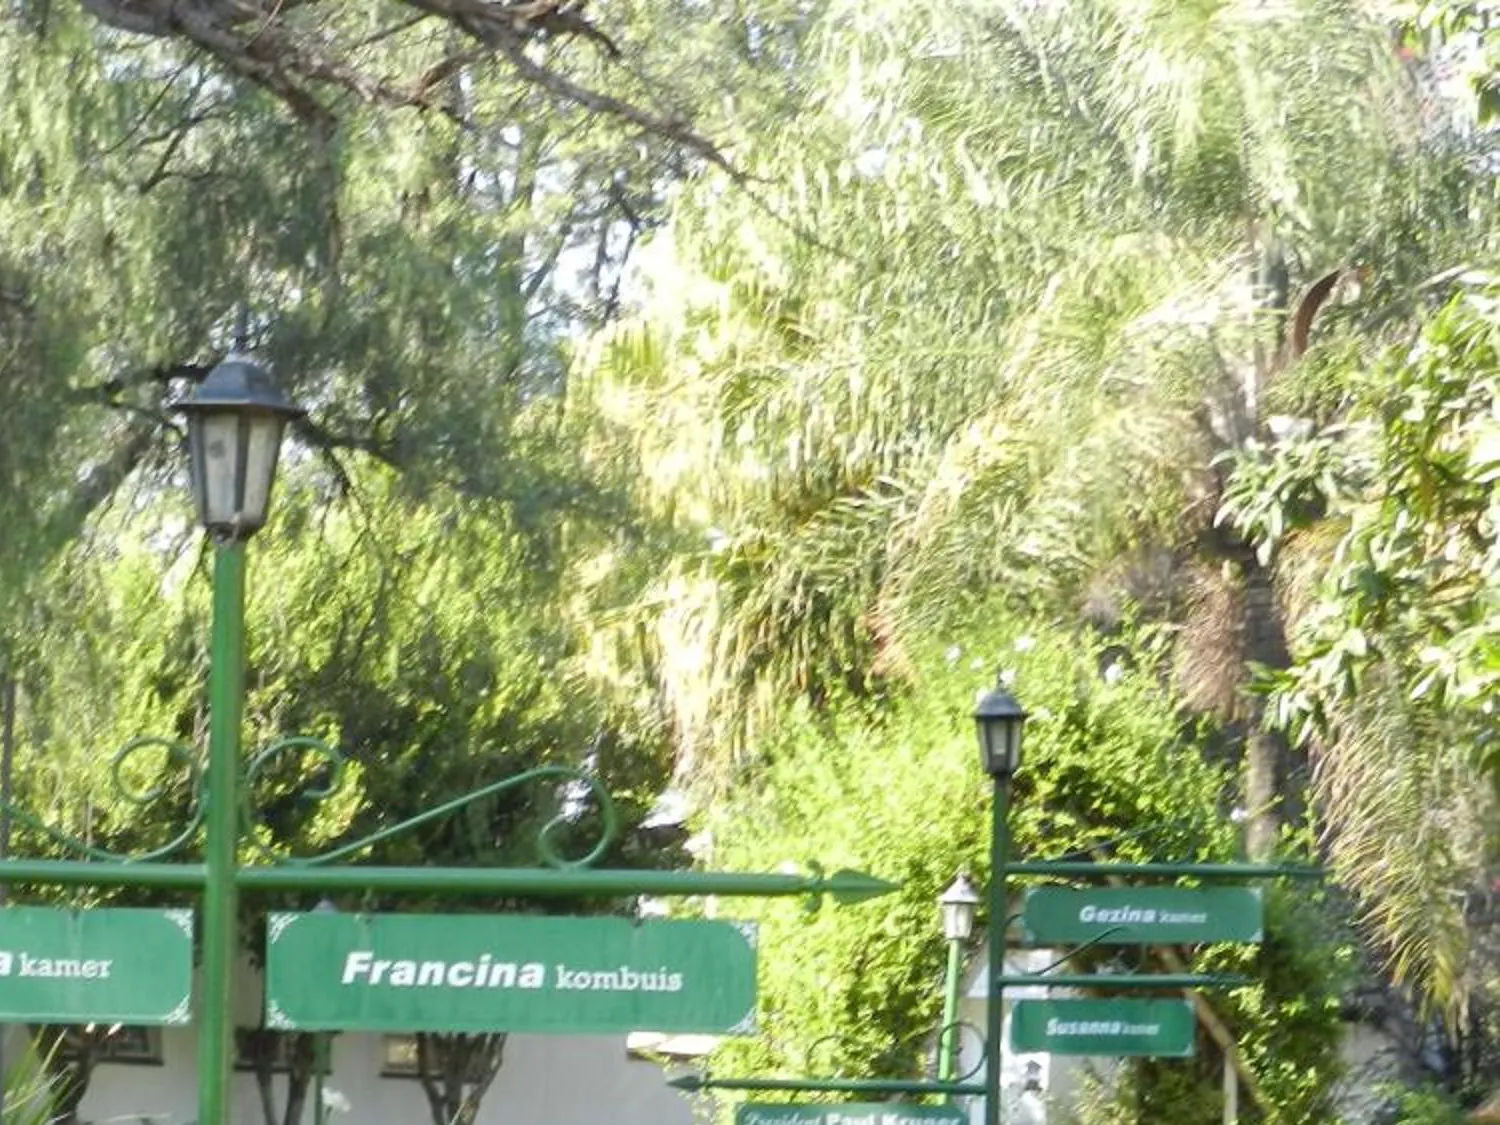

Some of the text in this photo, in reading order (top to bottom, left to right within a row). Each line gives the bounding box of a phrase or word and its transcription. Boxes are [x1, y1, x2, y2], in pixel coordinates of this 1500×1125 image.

[1079, 904, 1157, 924] Gezina
[19, 952, 113, 979] kamer
[341, 951, 683, 992] Francina kombuis
